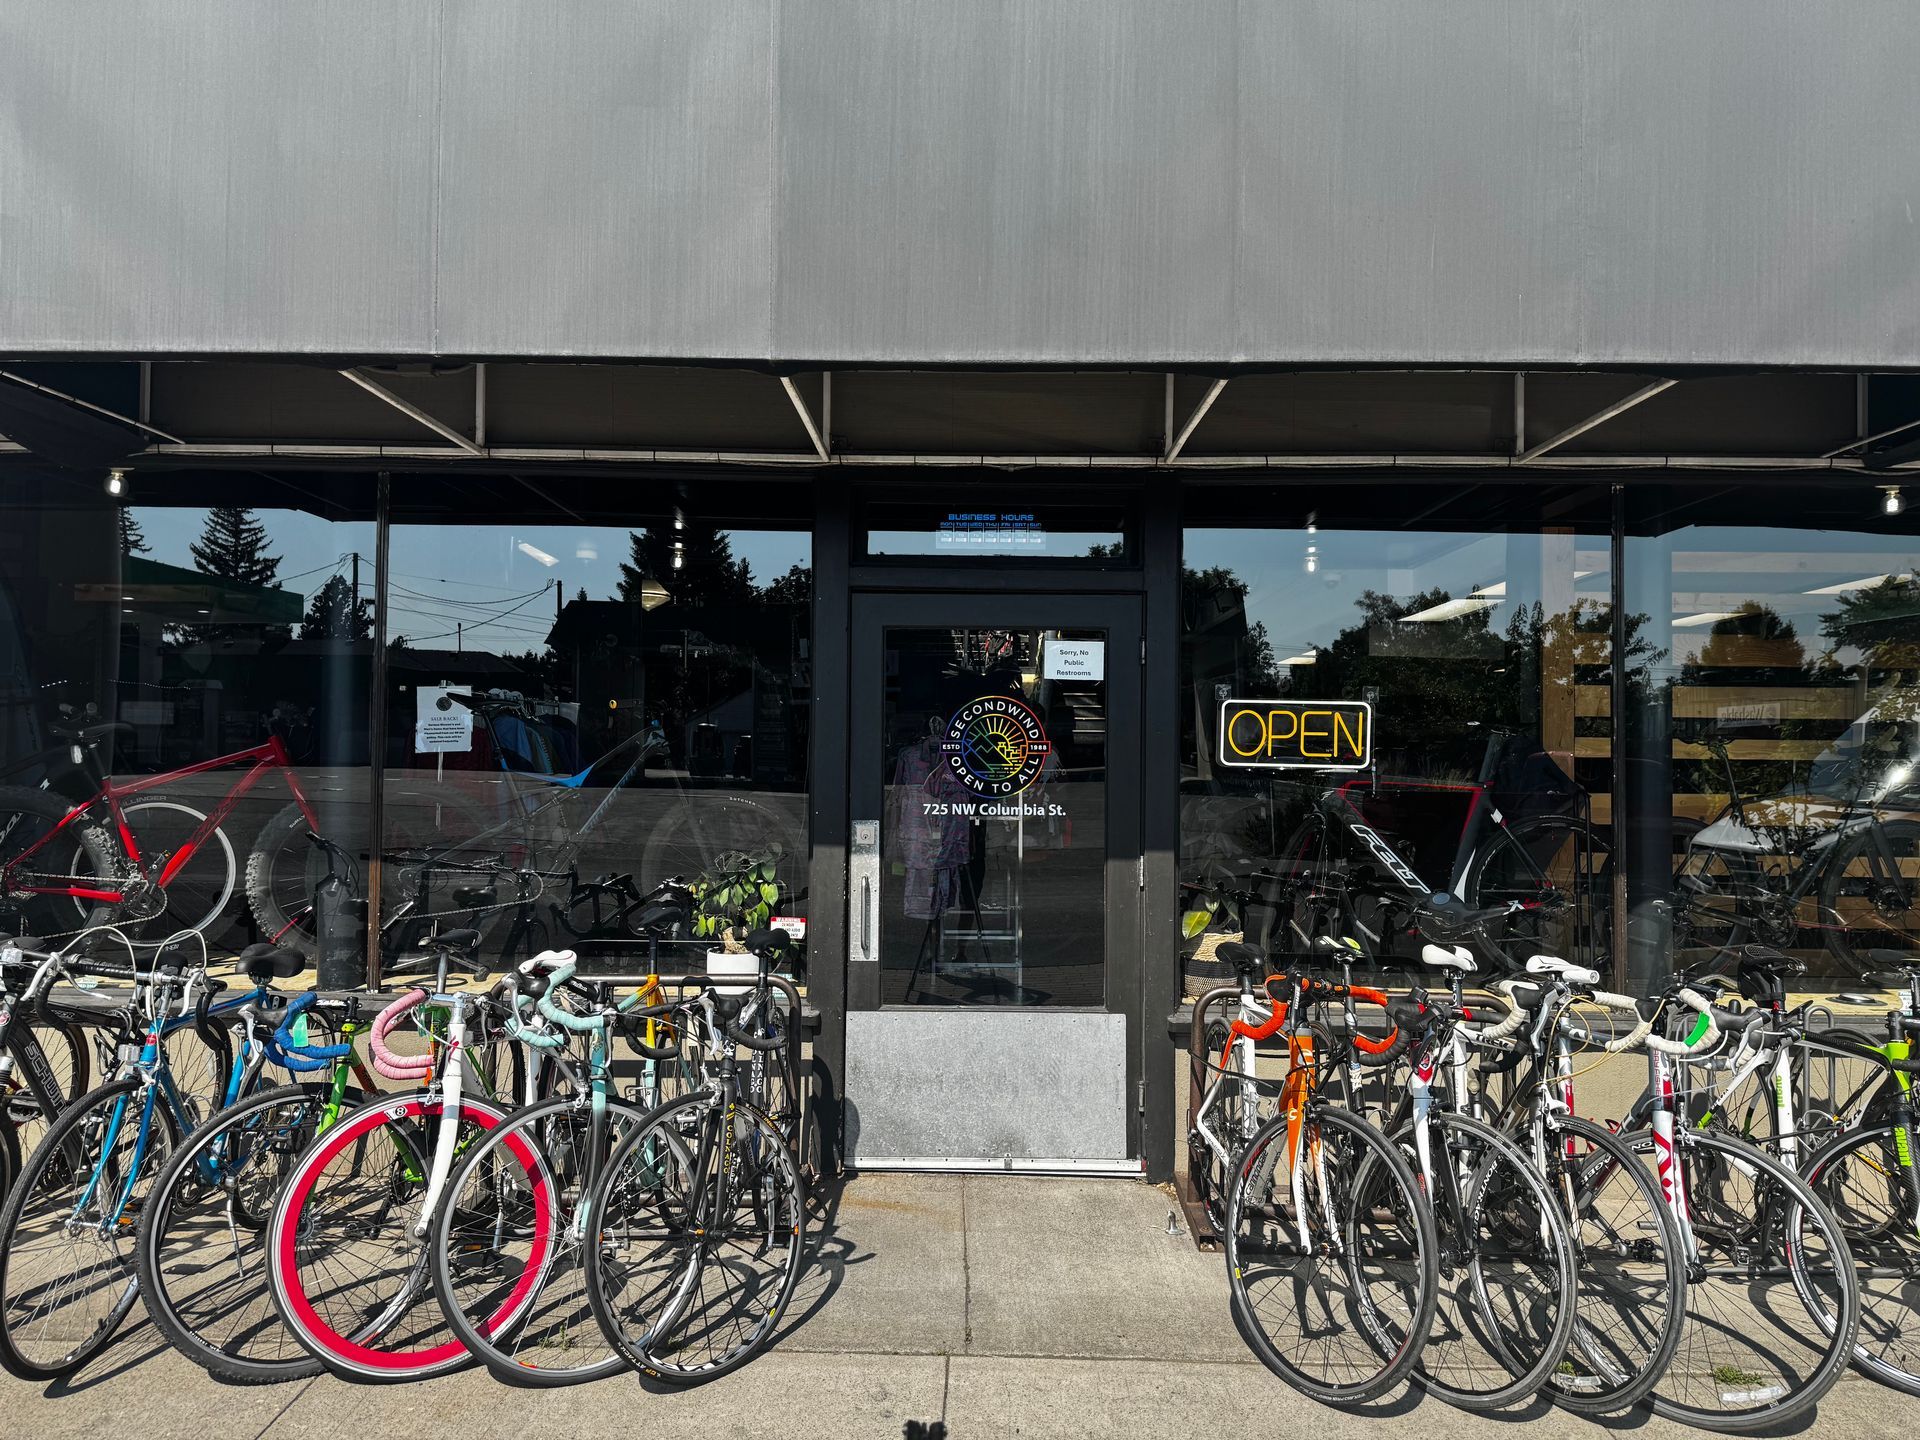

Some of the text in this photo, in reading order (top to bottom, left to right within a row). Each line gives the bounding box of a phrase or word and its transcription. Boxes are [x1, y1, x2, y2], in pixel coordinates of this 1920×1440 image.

[948, 513, 996, 521] BUSINESS
[950, 701, 1039, 739] SECONDWIND
[1228, 709, 1363, 757] OPEN
[951, 756, 1040, 794] OPEN TO ALL
[123, 795, 167, 806] ILLINGER
[922, 804, 1066, 816] 725 NW Columbia St.
[723, 1125, 733, 1174] COLNAGO
[1246, 1150, 1269, 1195] cannondale
[1832, 1320, 1854, 1373] BONTRAGER
